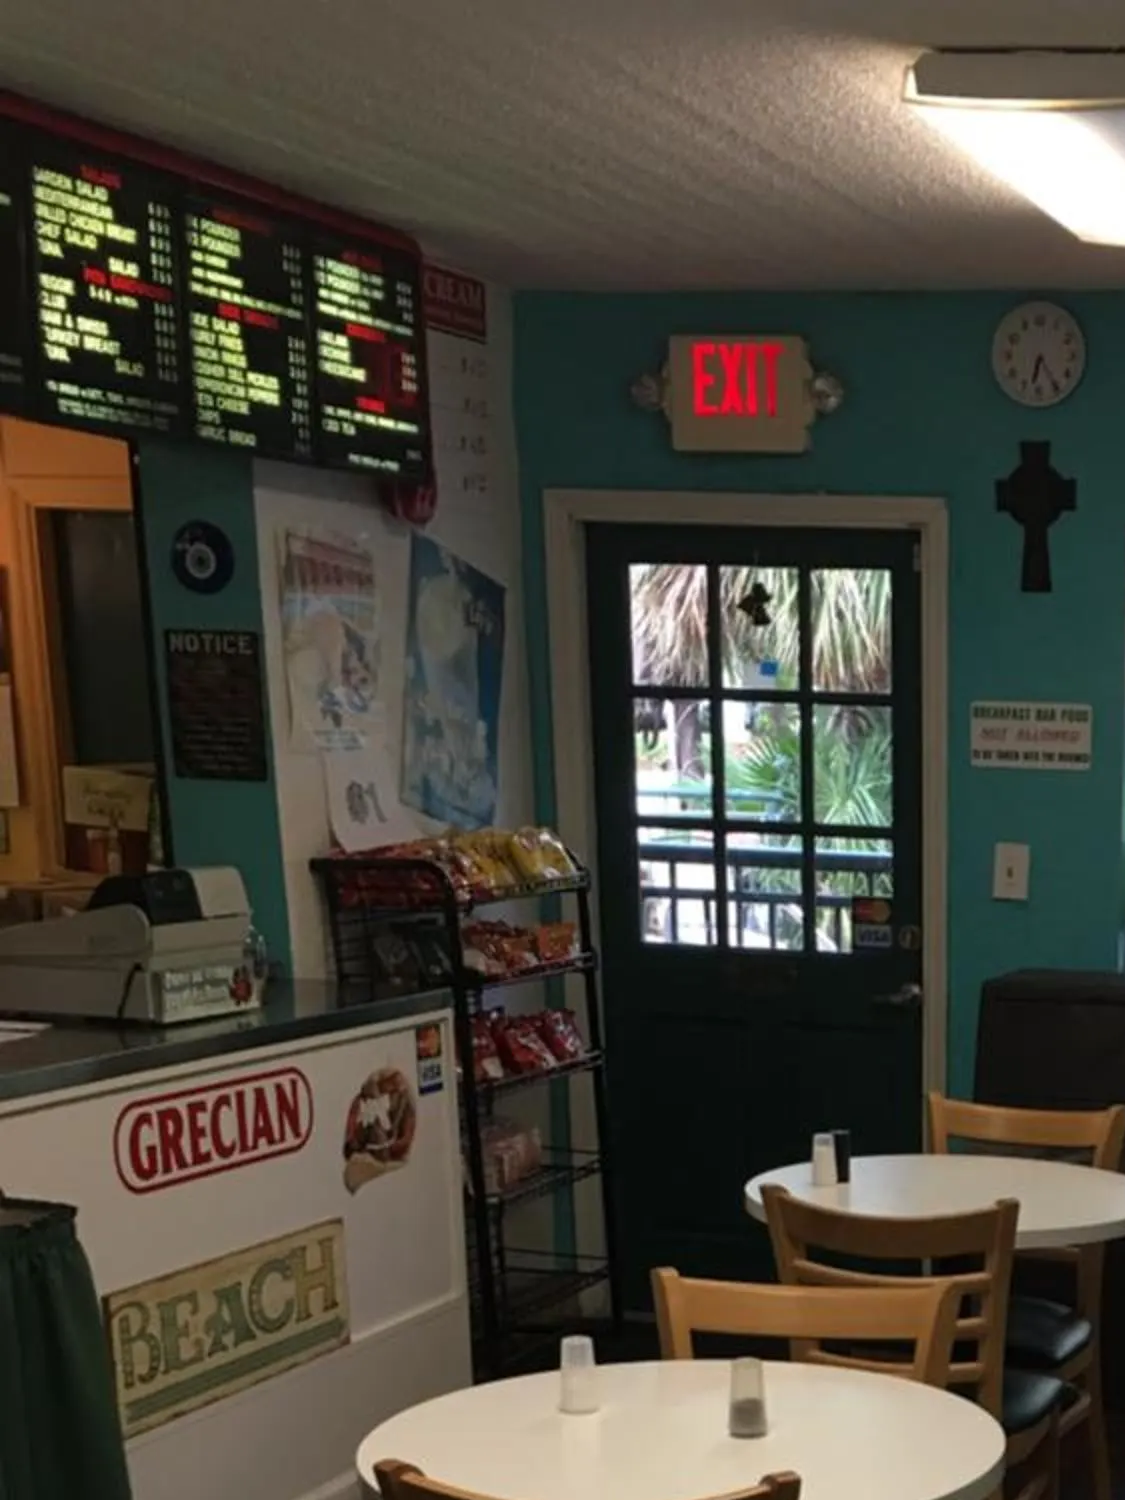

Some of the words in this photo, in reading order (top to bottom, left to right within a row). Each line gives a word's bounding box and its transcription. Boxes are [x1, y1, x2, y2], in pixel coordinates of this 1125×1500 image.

[690, 341, 786, 419] EXIT
[169, 633, 254, 656] NOTICE
[973, 705, 1031, 721] BREAKFAST
[860, 929, 889, 942] VISA
[128, 1078, 303, 1181] GRECIAN
[108, 1236, 340, 1390] BEACH
